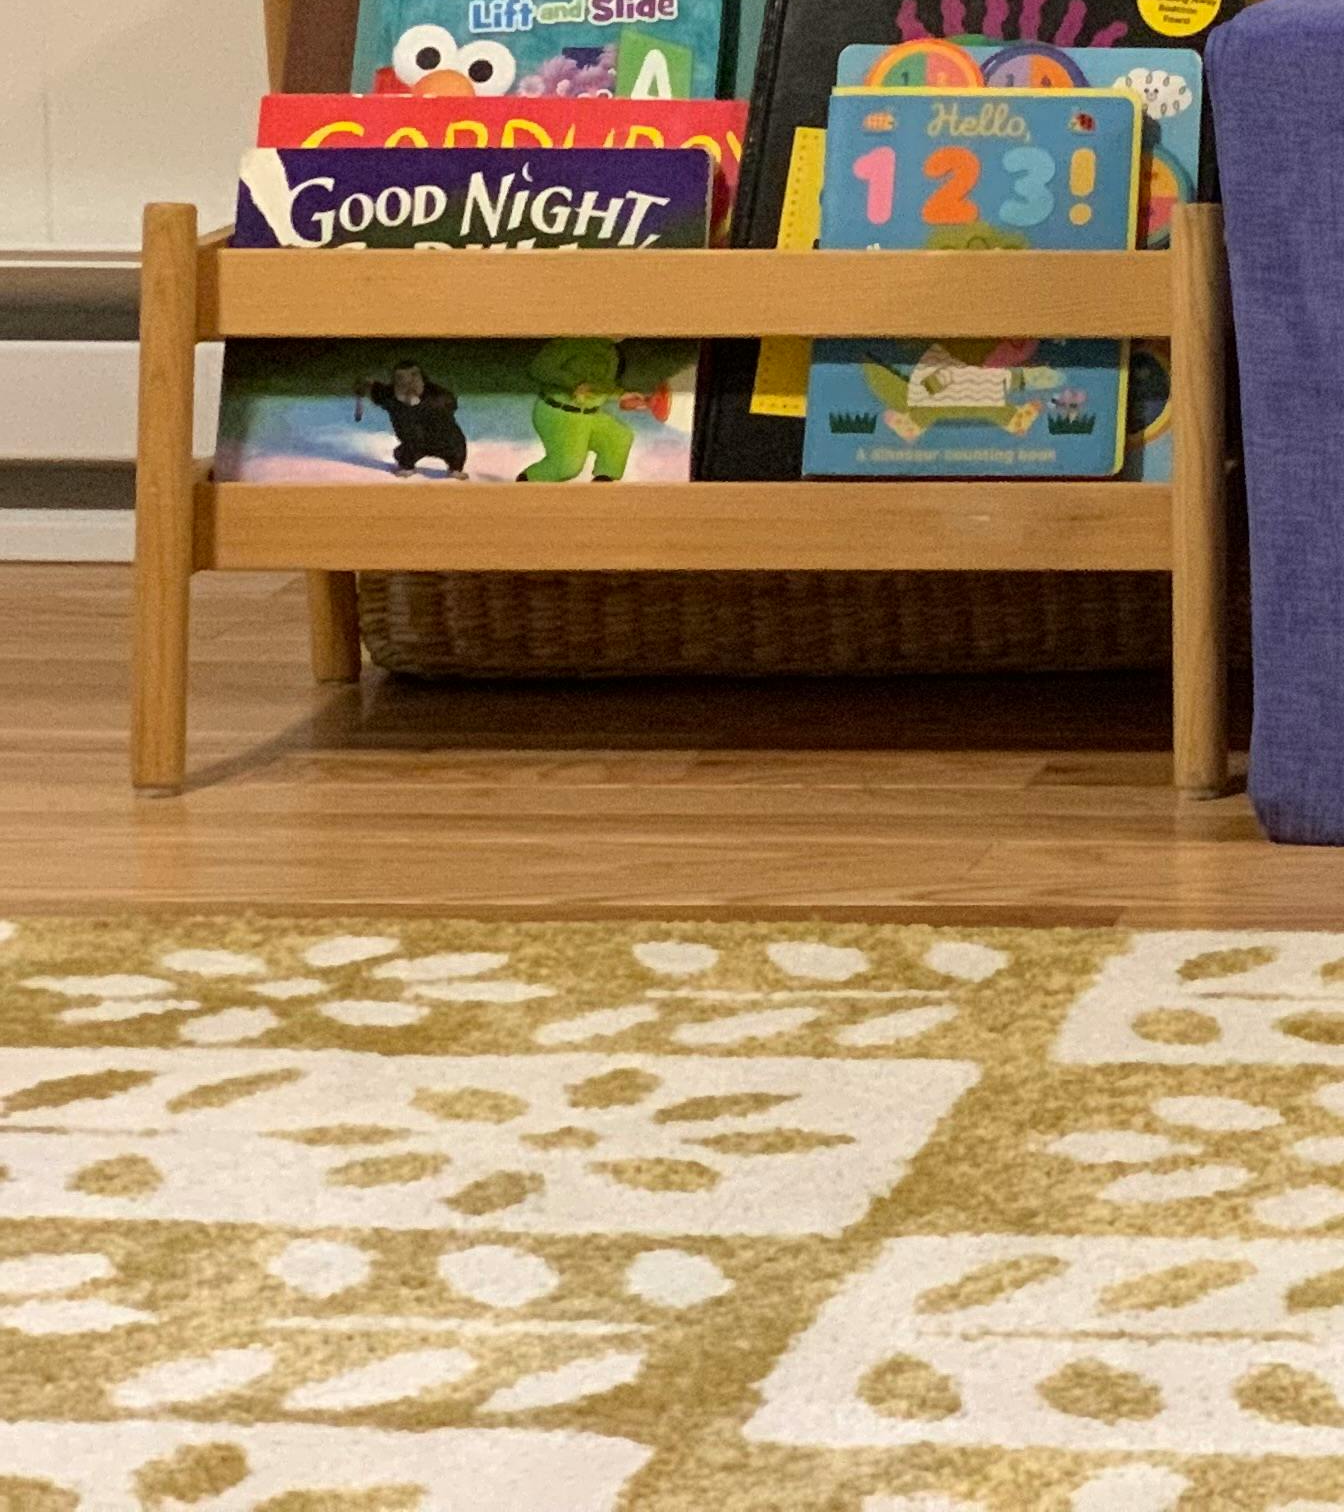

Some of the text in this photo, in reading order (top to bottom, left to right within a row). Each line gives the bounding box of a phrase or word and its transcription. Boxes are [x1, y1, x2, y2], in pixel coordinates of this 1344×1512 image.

[539, 0, 584, 22] and
[927, 103, 1030, 142] Hello,
[288, 177, 448, 248] GOOD
